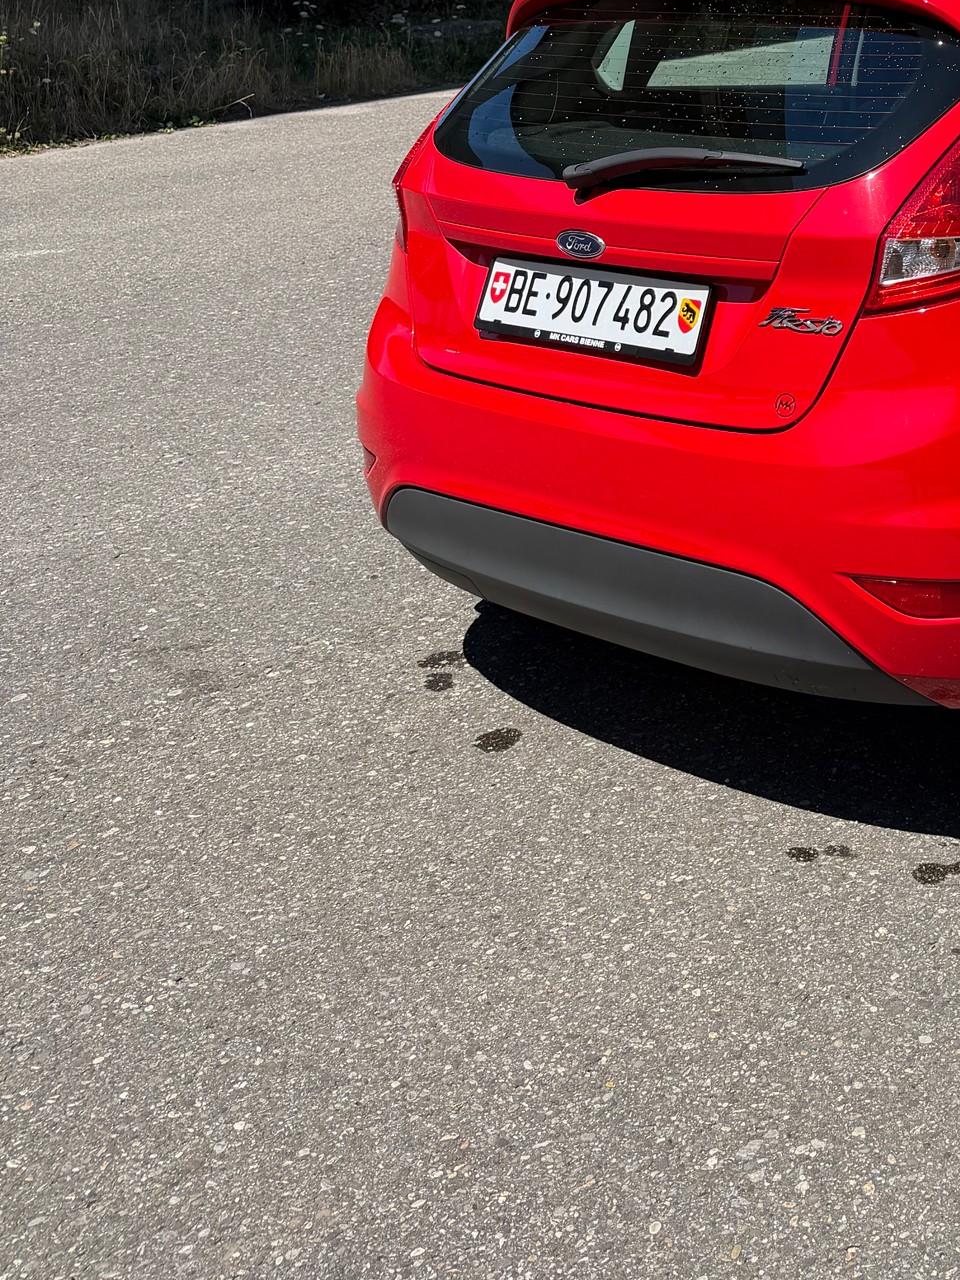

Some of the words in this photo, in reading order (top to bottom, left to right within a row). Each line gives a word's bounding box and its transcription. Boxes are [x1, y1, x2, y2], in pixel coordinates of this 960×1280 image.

[566, 235, 592, 252] Ford
[758, 307, 843, 334] Fiesta
[549, 332, 561, 341] MK
[560, 334, 580, 345] CARS
[580, 337, 606, 349] BIENNE
